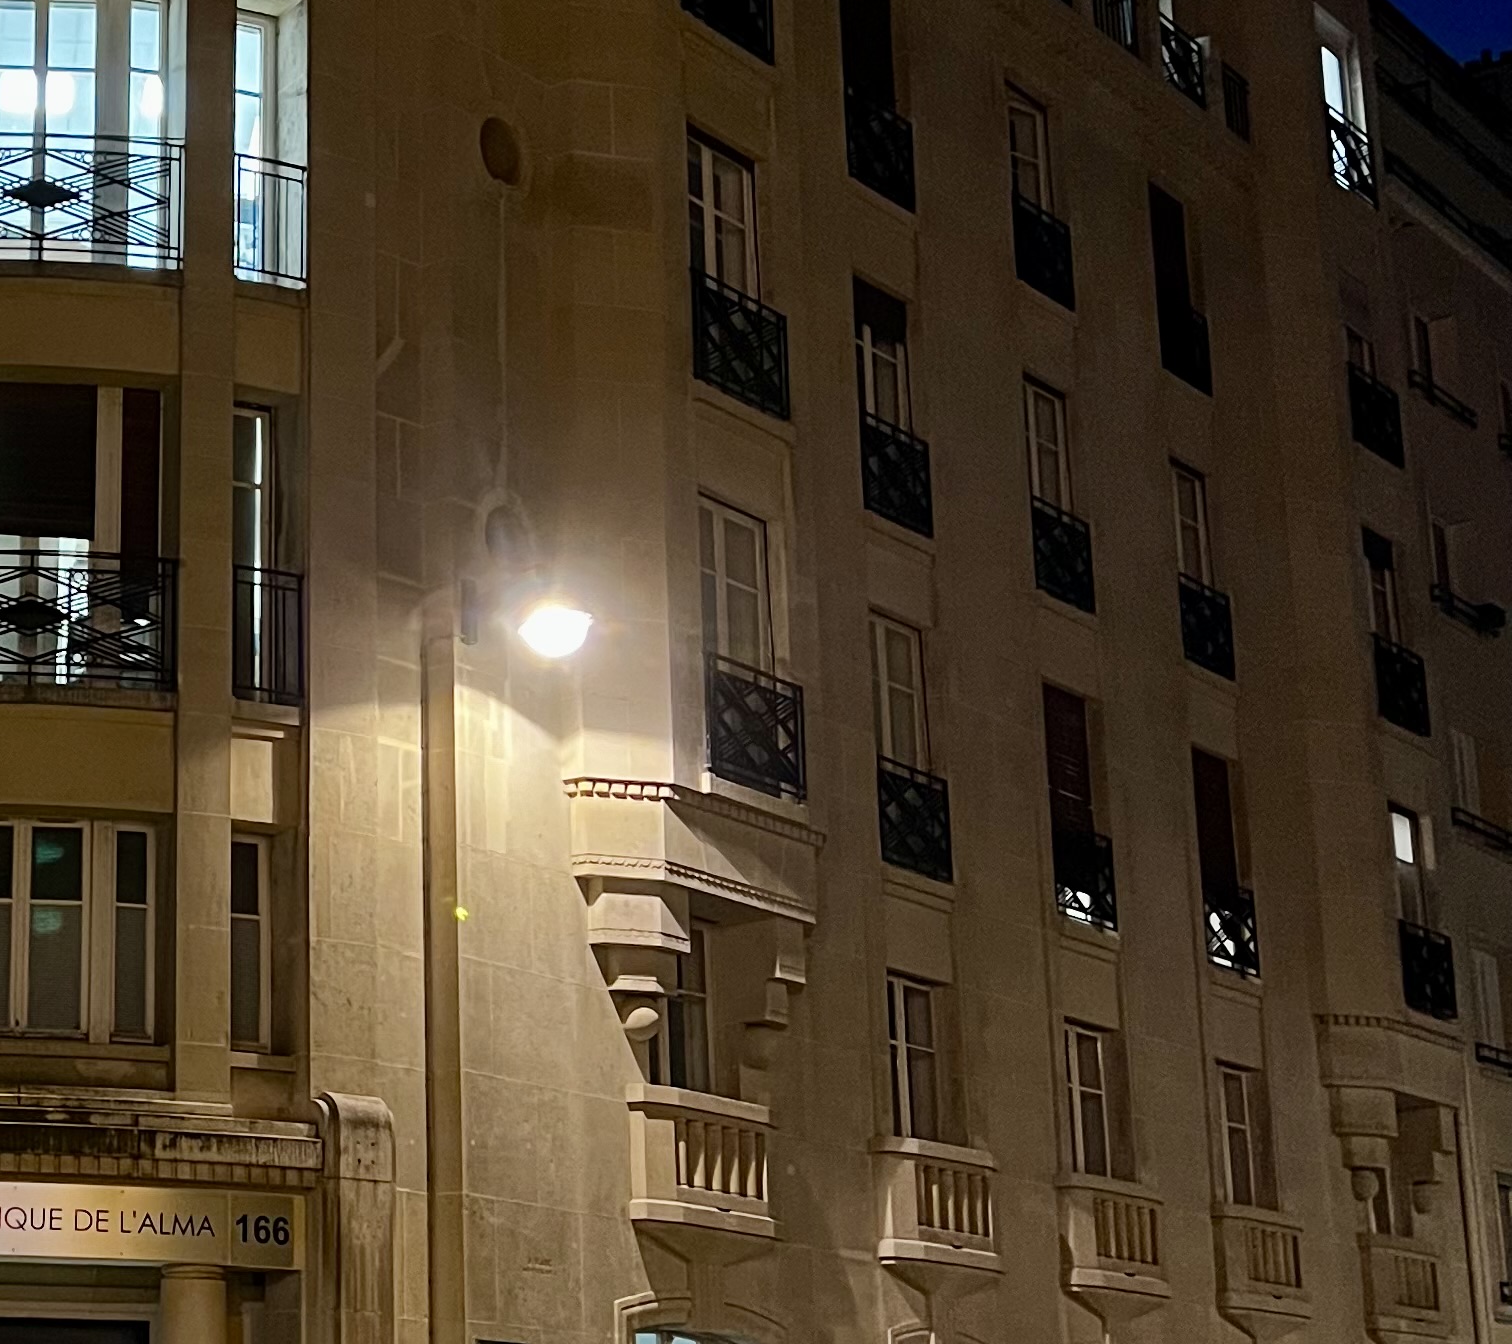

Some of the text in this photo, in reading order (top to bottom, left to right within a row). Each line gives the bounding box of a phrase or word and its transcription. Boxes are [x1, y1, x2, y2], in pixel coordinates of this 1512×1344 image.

[74, 1208, 110, 1233] DE
[120, 1210, 216, 1237] L'ALMA
[235, 1214, 290, 1246] 166
